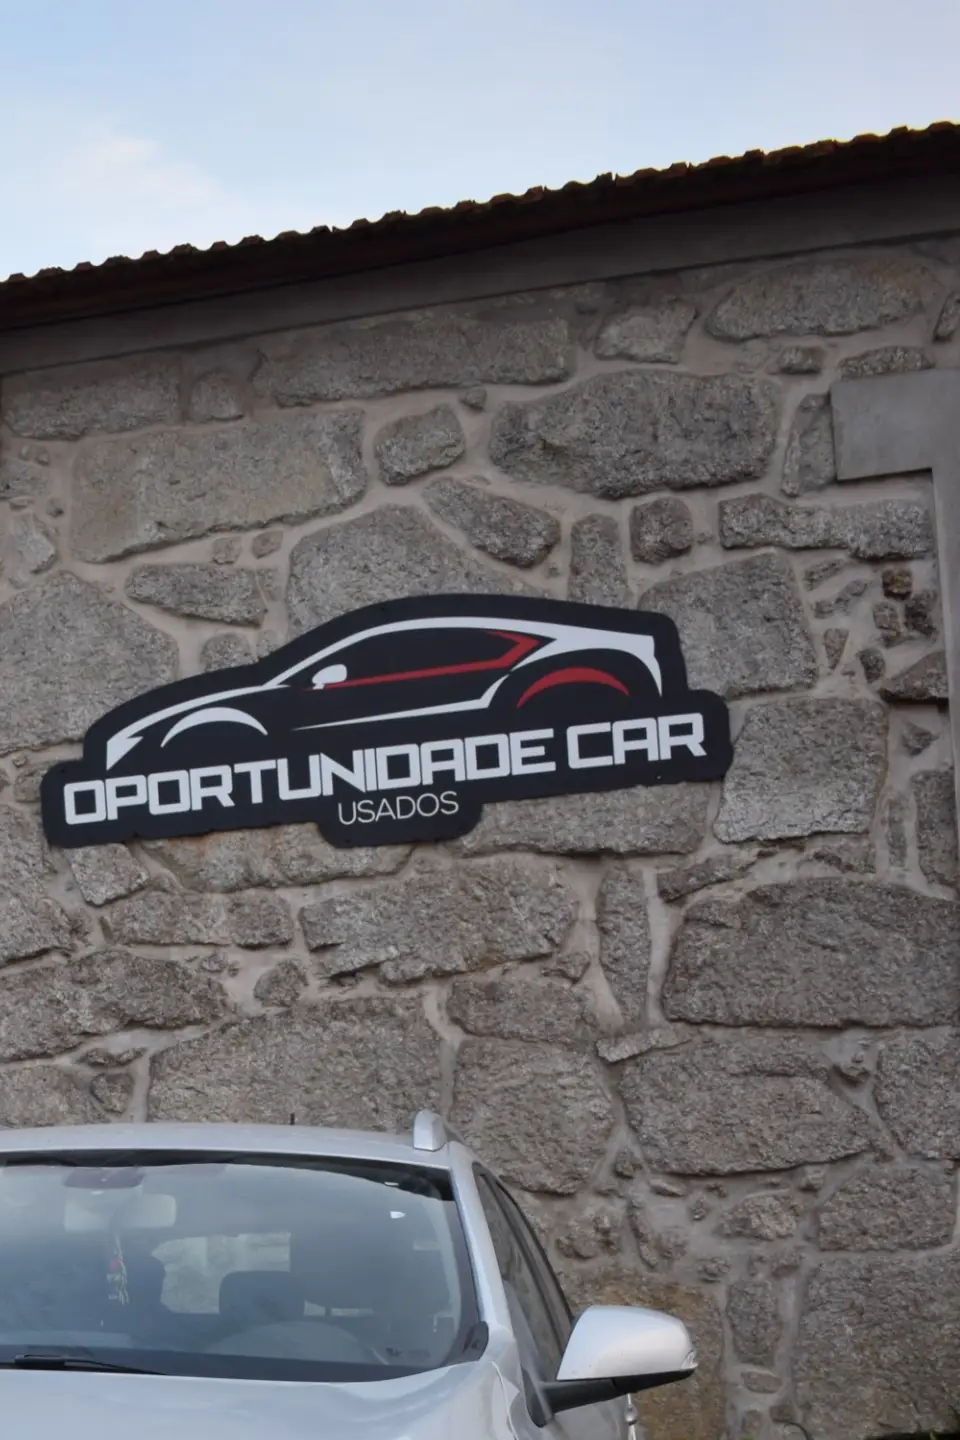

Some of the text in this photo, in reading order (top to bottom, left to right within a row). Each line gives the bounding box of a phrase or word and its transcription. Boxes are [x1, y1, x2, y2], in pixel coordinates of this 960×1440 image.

[64, 712, 707, 825] OPORTUNIDADE CAR
[338, 791, 459, 825] USADOS
